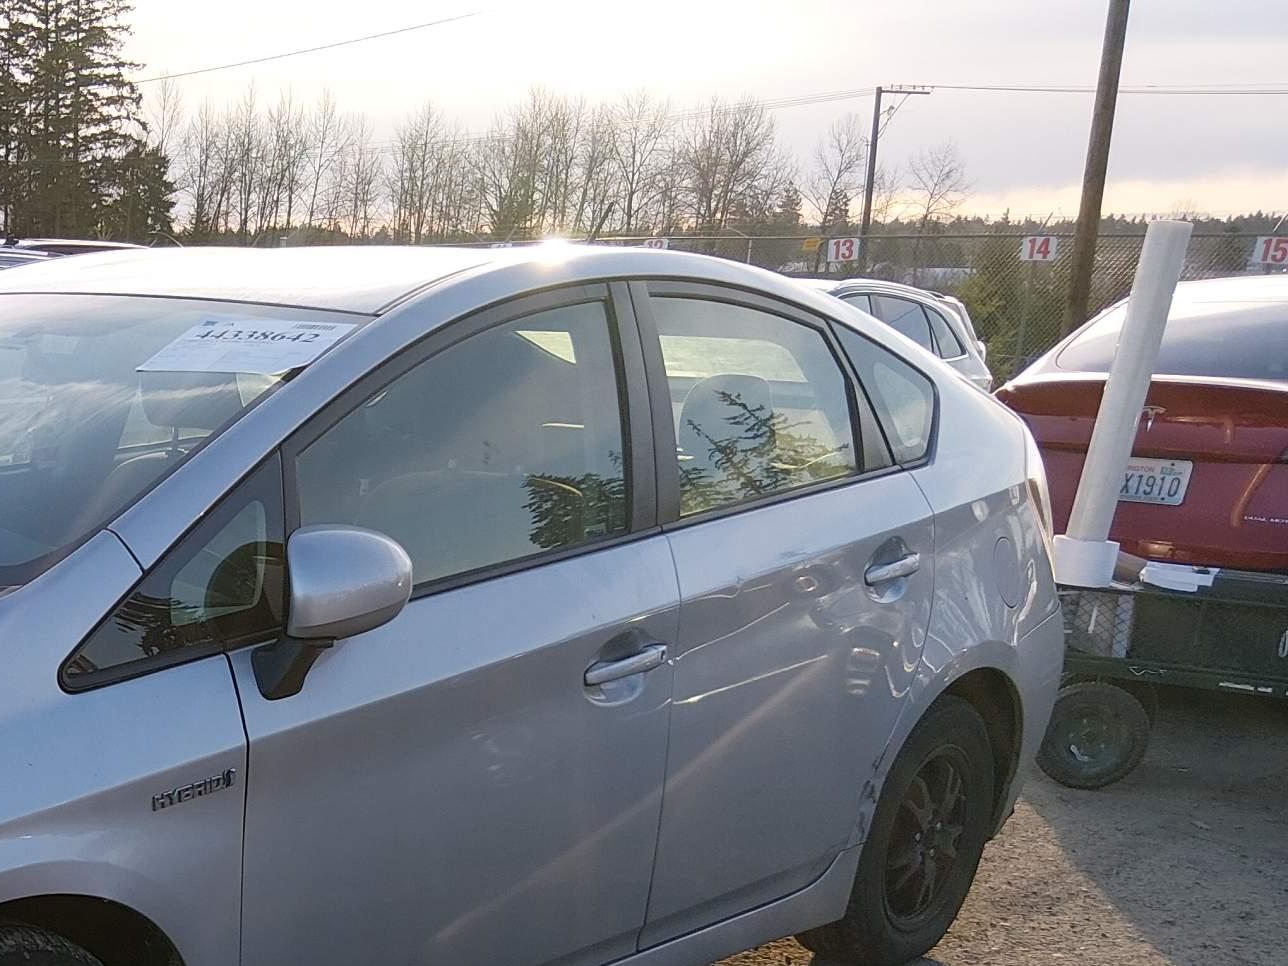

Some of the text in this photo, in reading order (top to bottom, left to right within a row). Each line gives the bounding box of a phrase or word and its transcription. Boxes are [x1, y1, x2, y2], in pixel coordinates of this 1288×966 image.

[833, 239, 855, 260] 13
[1028, 238, 1051, 260] 14
[1262, 238, 1288, 263] 15
[195, 328, 321, 344] 44338642
[152, 770, 227, 812] HYBRID
